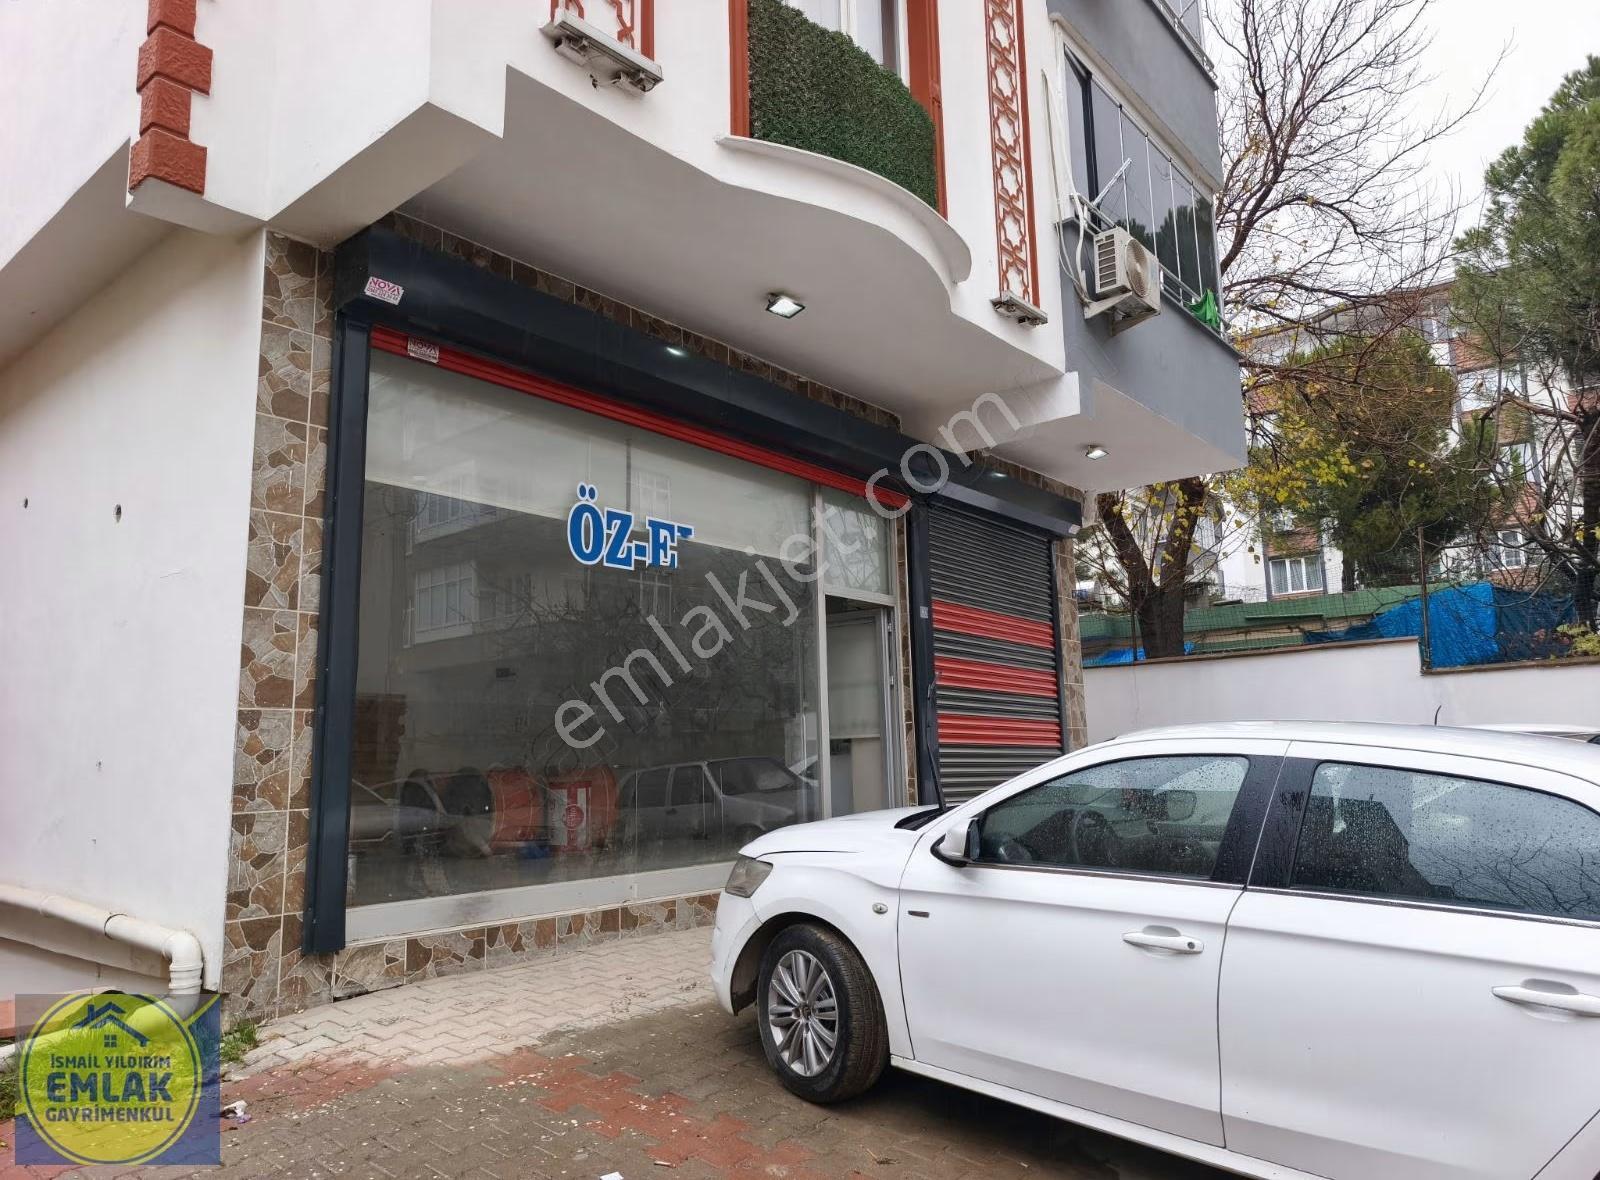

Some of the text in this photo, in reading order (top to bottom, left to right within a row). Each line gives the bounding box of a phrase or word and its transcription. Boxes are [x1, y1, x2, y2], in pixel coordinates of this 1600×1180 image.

[369, 278, 401, 295] NOVA
[408, 337, 438, 355] NOVA
[567, 481, 695, 571] ÖZ-E
